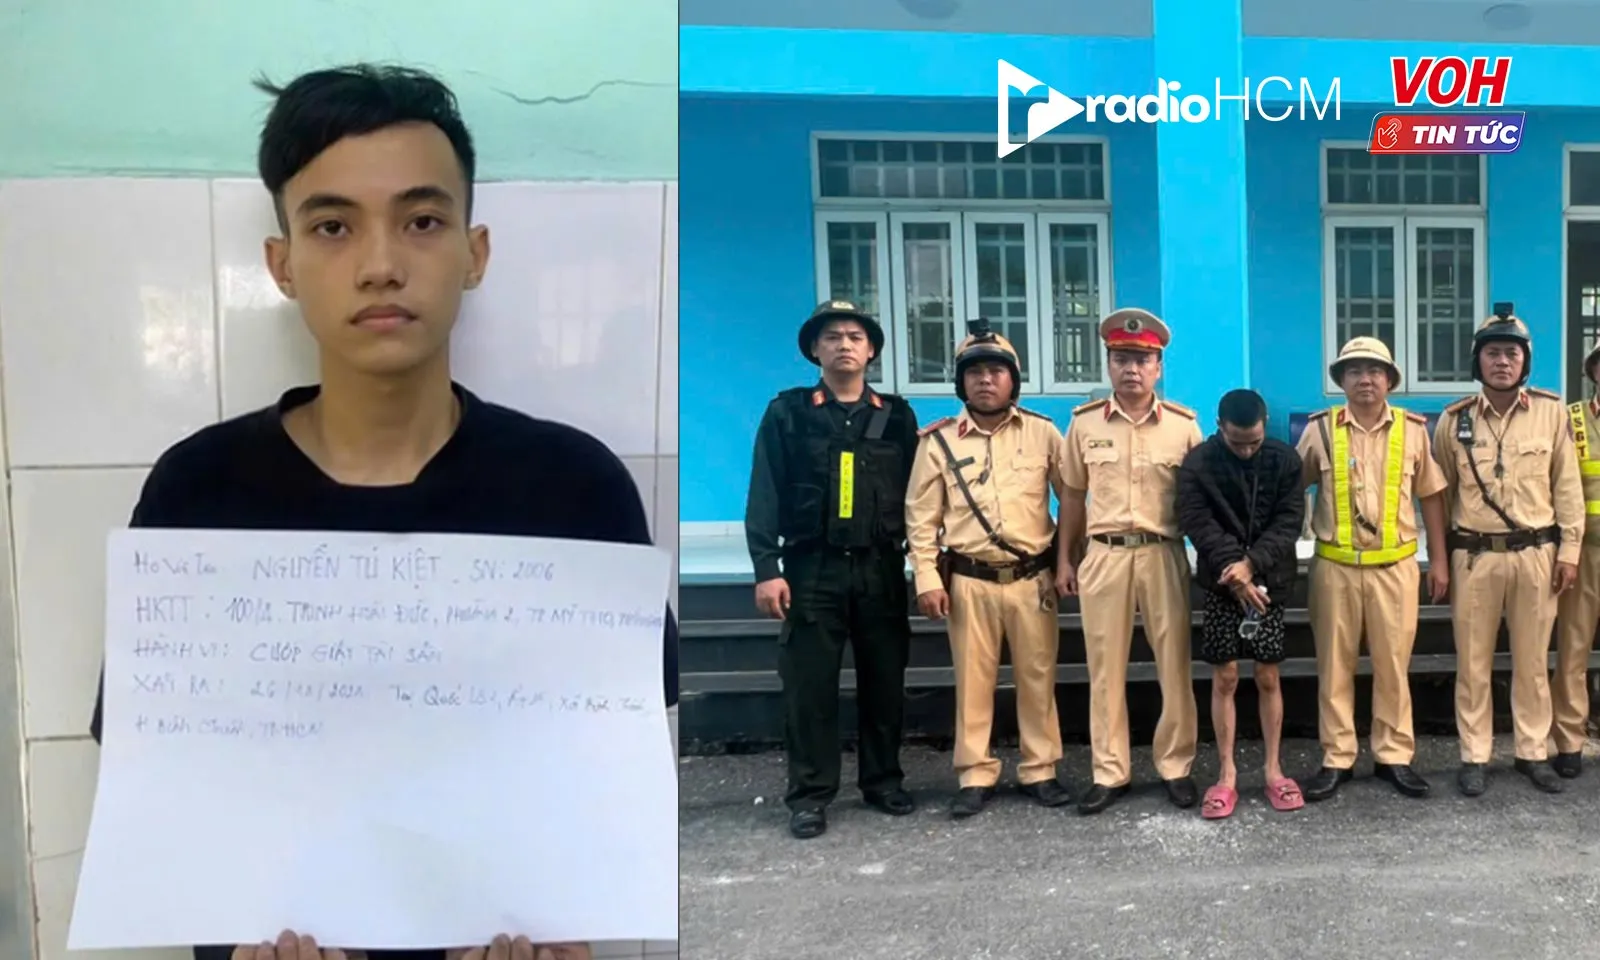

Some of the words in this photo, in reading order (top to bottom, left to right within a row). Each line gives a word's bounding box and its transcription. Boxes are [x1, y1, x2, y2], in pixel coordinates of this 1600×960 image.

[1570, 403, 1586, 458] CSGT
[252, 543, 340, 581] NGUYỄN
[350, 546, 379, 580] TÚ
[512, 562, 555, 582] 2006
